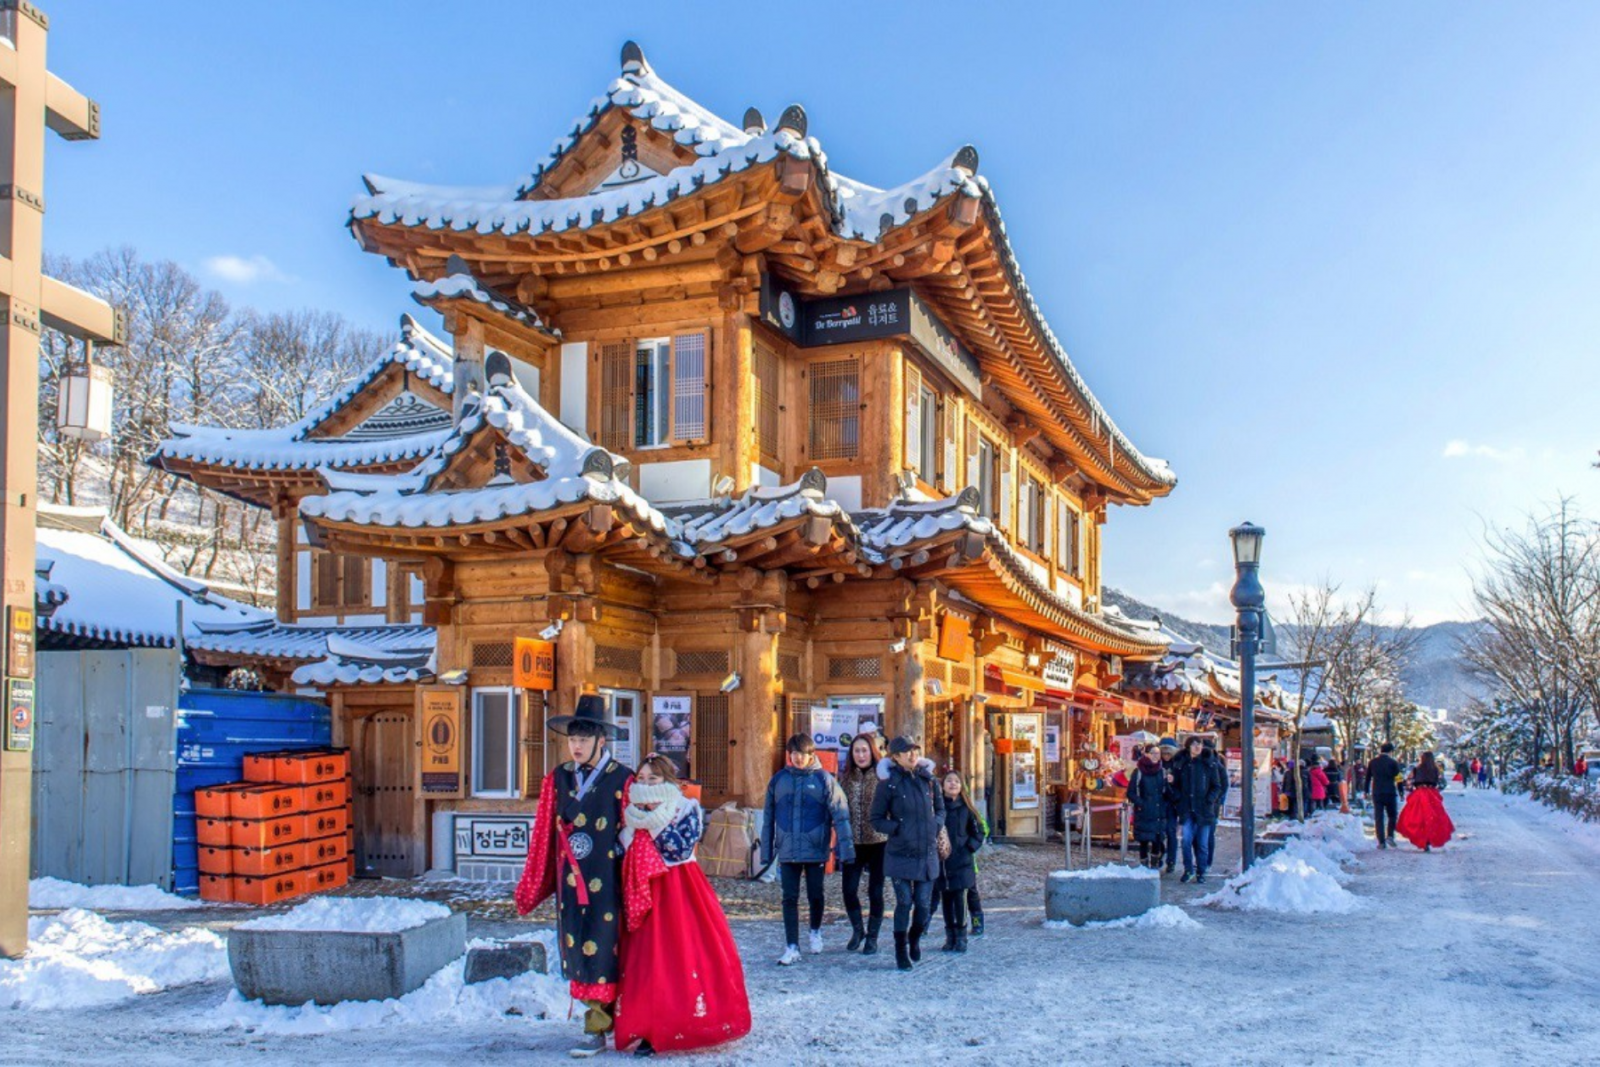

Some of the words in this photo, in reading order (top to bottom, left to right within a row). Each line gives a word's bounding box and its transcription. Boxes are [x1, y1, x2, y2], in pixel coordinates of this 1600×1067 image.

[536, 656, 552, 672] PNB
[432, 755, 449, 765] PNB
[476, 826, 526, 849] 정남헌
